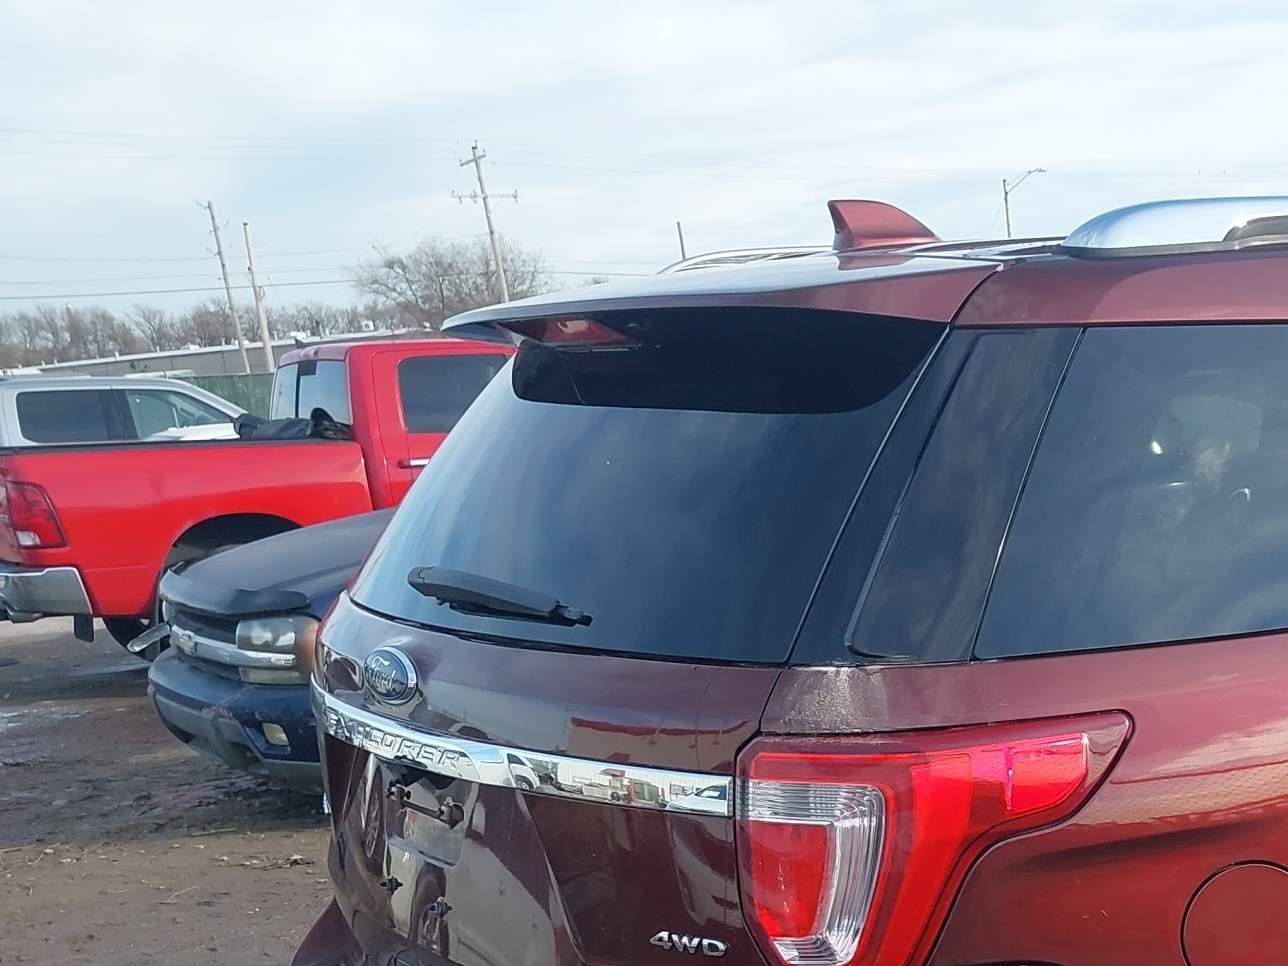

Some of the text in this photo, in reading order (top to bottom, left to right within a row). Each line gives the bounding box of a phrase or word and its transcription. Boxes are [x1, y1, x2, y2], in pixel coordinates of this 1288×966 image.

[367, 656, 396, 690] Ford
[325, 707, 461, 770] EXPLORER
[649, 930, 728, 957] 4WD
